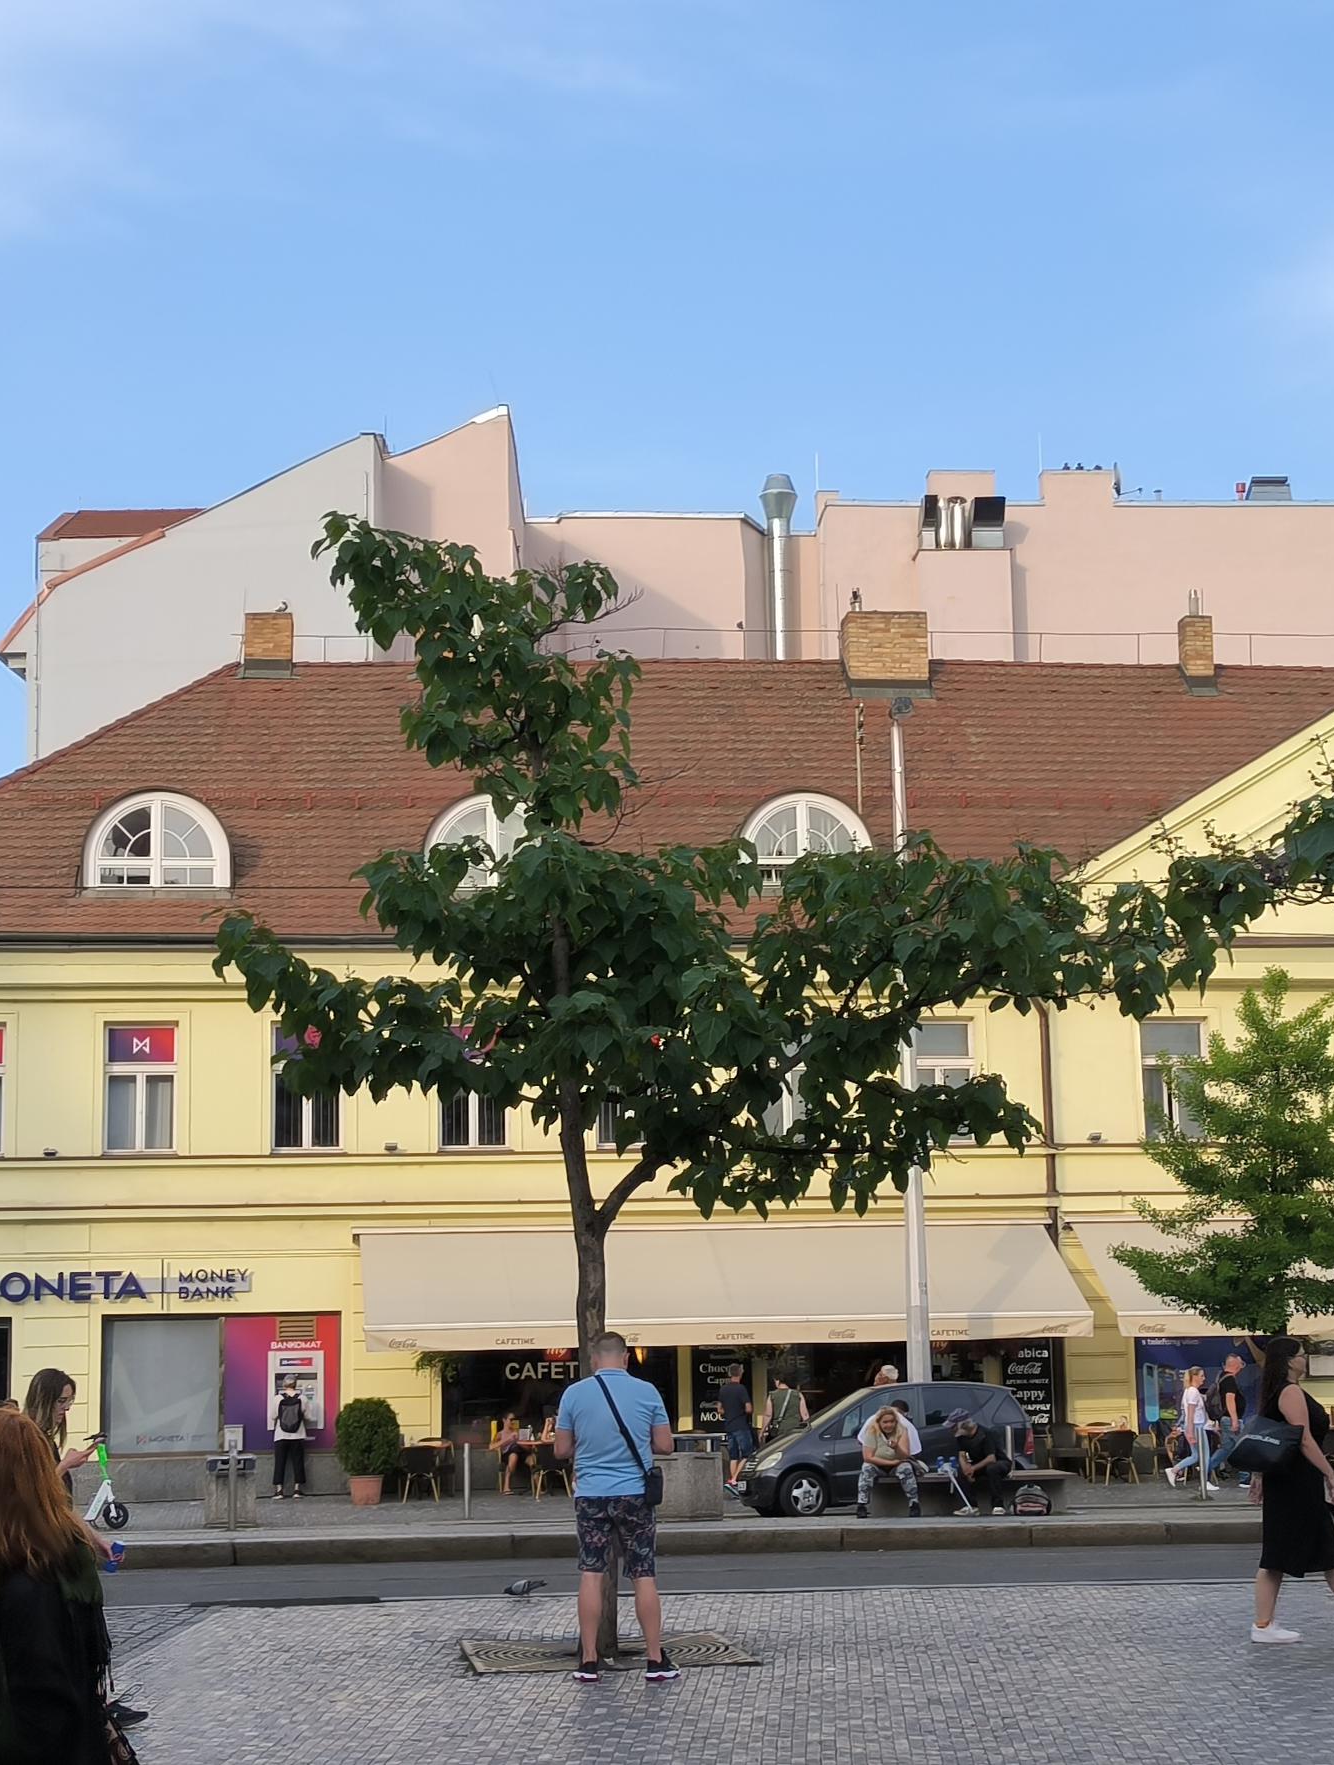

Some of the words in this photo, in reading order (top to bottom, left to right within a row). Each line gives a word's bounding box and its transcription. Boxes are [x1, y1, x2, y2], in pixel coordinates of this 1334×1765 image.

[178, 1268, 248, 1284] MONEY
[177, 1285, 234, 1300] BANK
[494, 1337, 536, 1346] CAFETIME
[715, 1332, 756, 1341] CAFETIME
[930, 1328, 970, 1337] CAFETIME
[270, 1340, 322, 1350] BANKOMAT
[1018, 1348, 1049, 1358] abica
[504, 1361, 579, 1380] CAFET
